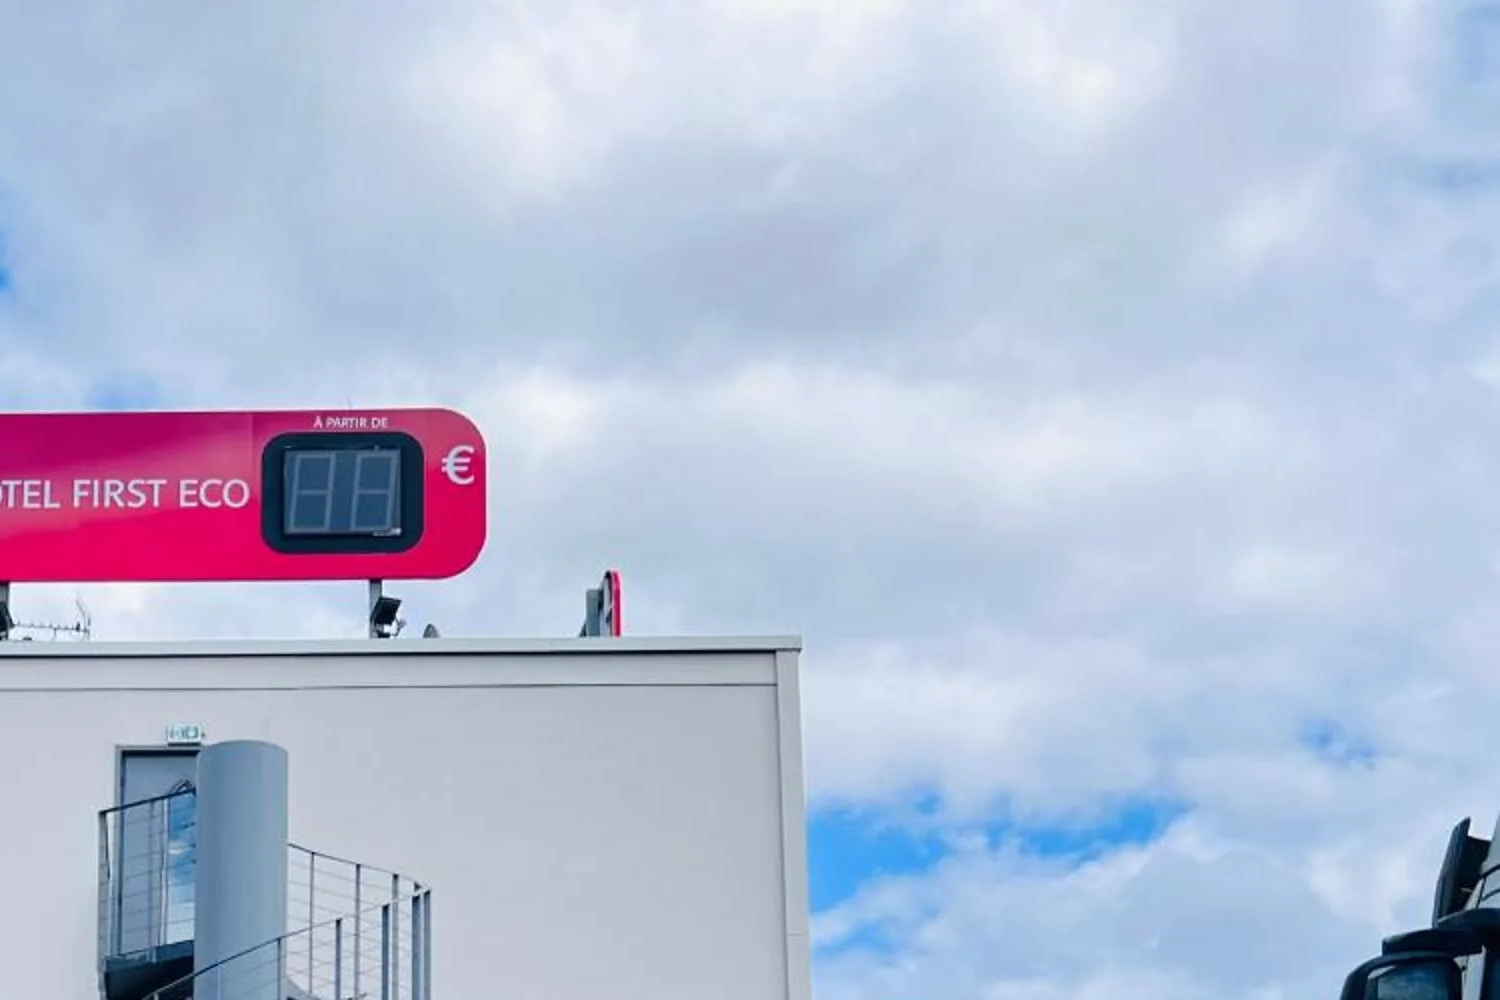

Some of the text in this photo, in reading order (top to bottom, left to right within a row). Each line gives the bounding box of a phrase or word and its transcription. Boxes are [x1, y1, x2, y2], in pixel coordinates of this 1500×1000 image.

[325, 417, 369, 429] PARTIR
[371, 417, 389, 429] DE
[441, 445, 475, 485] €
[73, 479, 167, 509] FIRST
[178, 479, 250, 509] ECO
